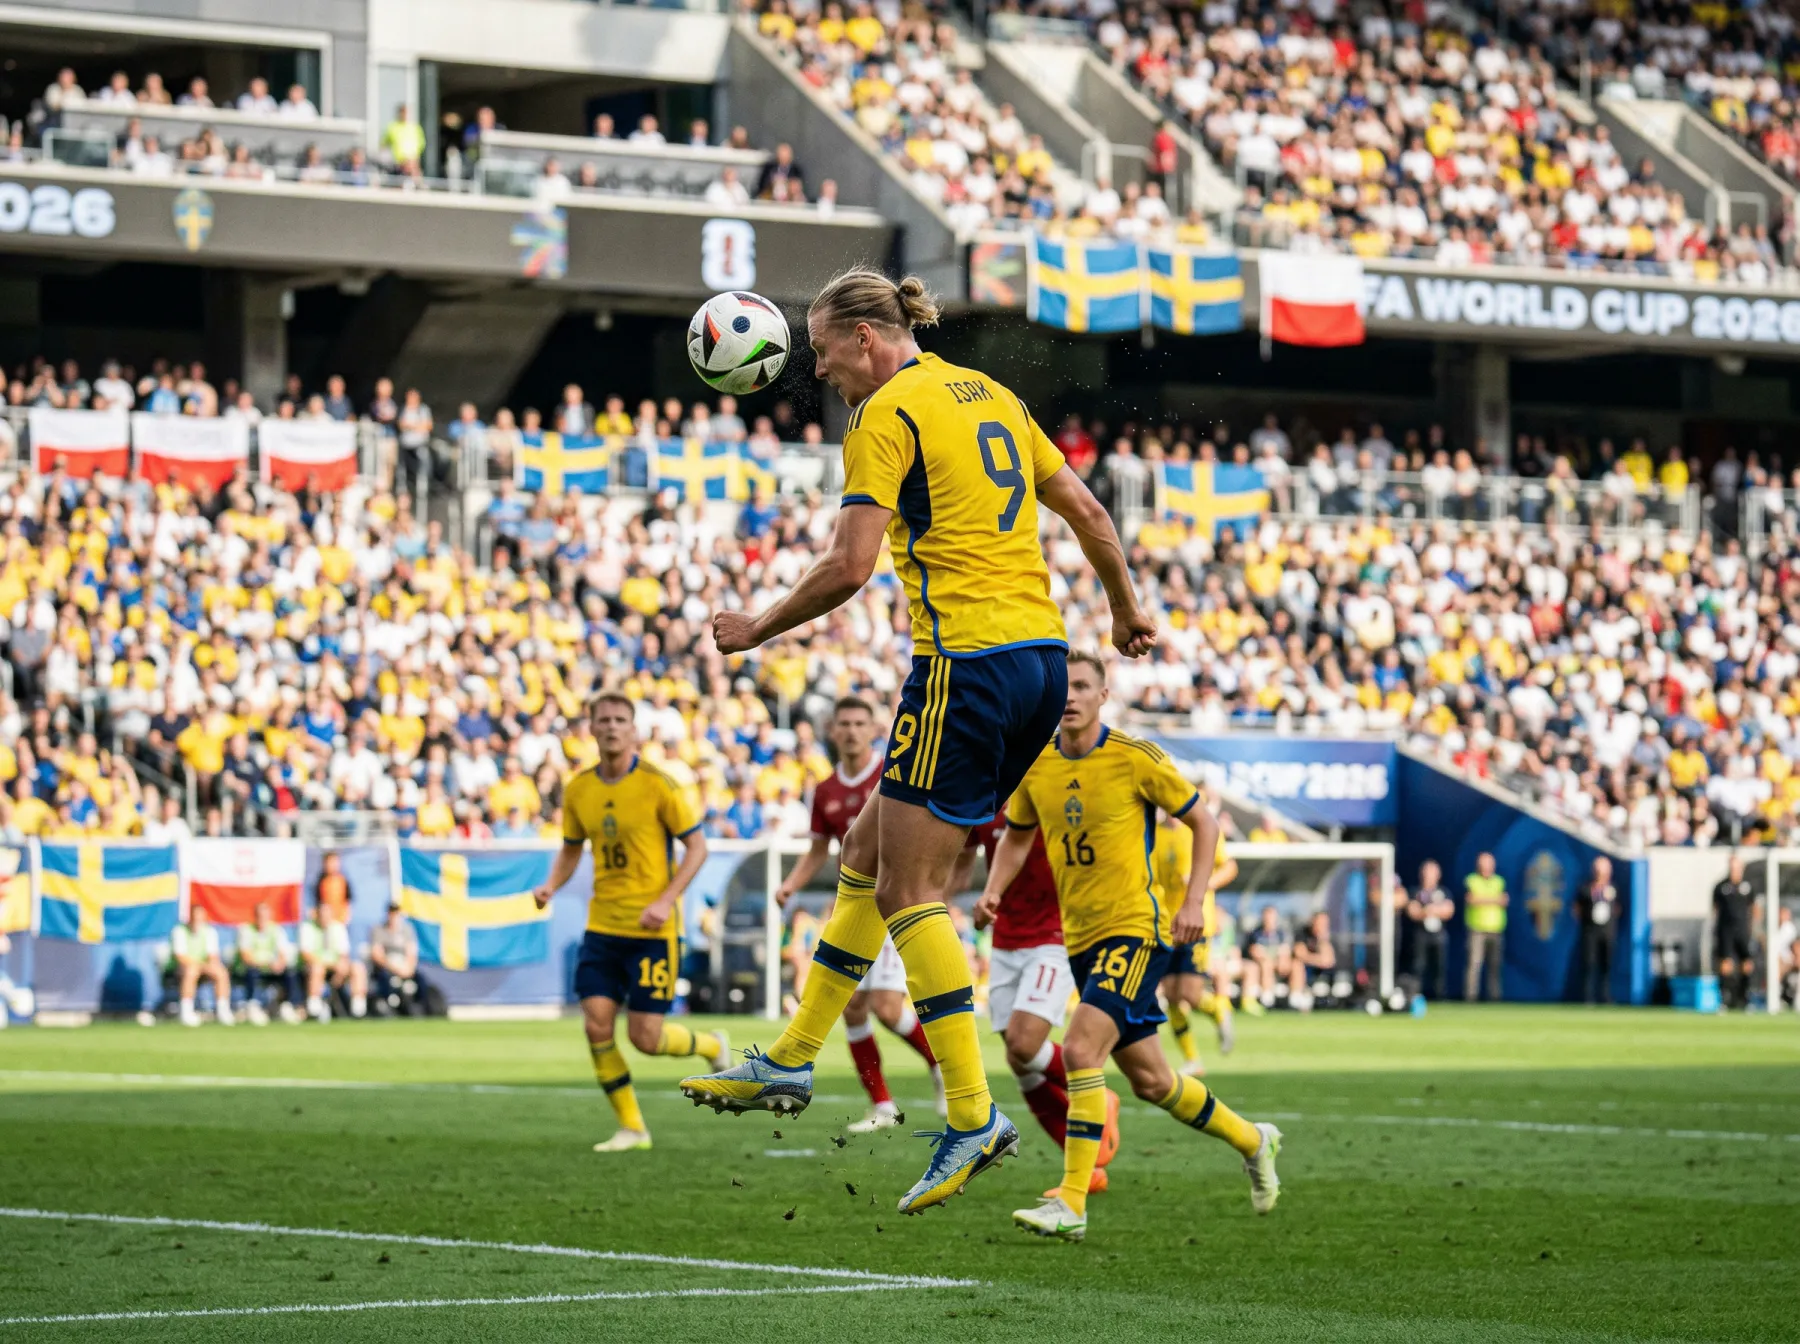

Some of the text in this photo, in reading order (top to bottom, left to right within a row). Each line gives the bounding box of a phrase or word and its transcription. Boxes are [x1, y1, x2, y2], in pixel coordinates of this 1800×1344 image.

[0, 182, 116, 238] 026
[1415, 276, 1589, 330] WORLD
[1590, 288, 1689, 337] CUP
[1691, 296, 1800, 343] 2026
[977, 421, 1027, 532] 9
[890, 712, 917, 759] 9
[602, 843, 628, 869] 16
[1062, 831, 1096, 867] 16
[638, 956, 669, 989] 16
[1035, 964, 1057, 993] 11
[1091, 944, 1129, 979] 16
